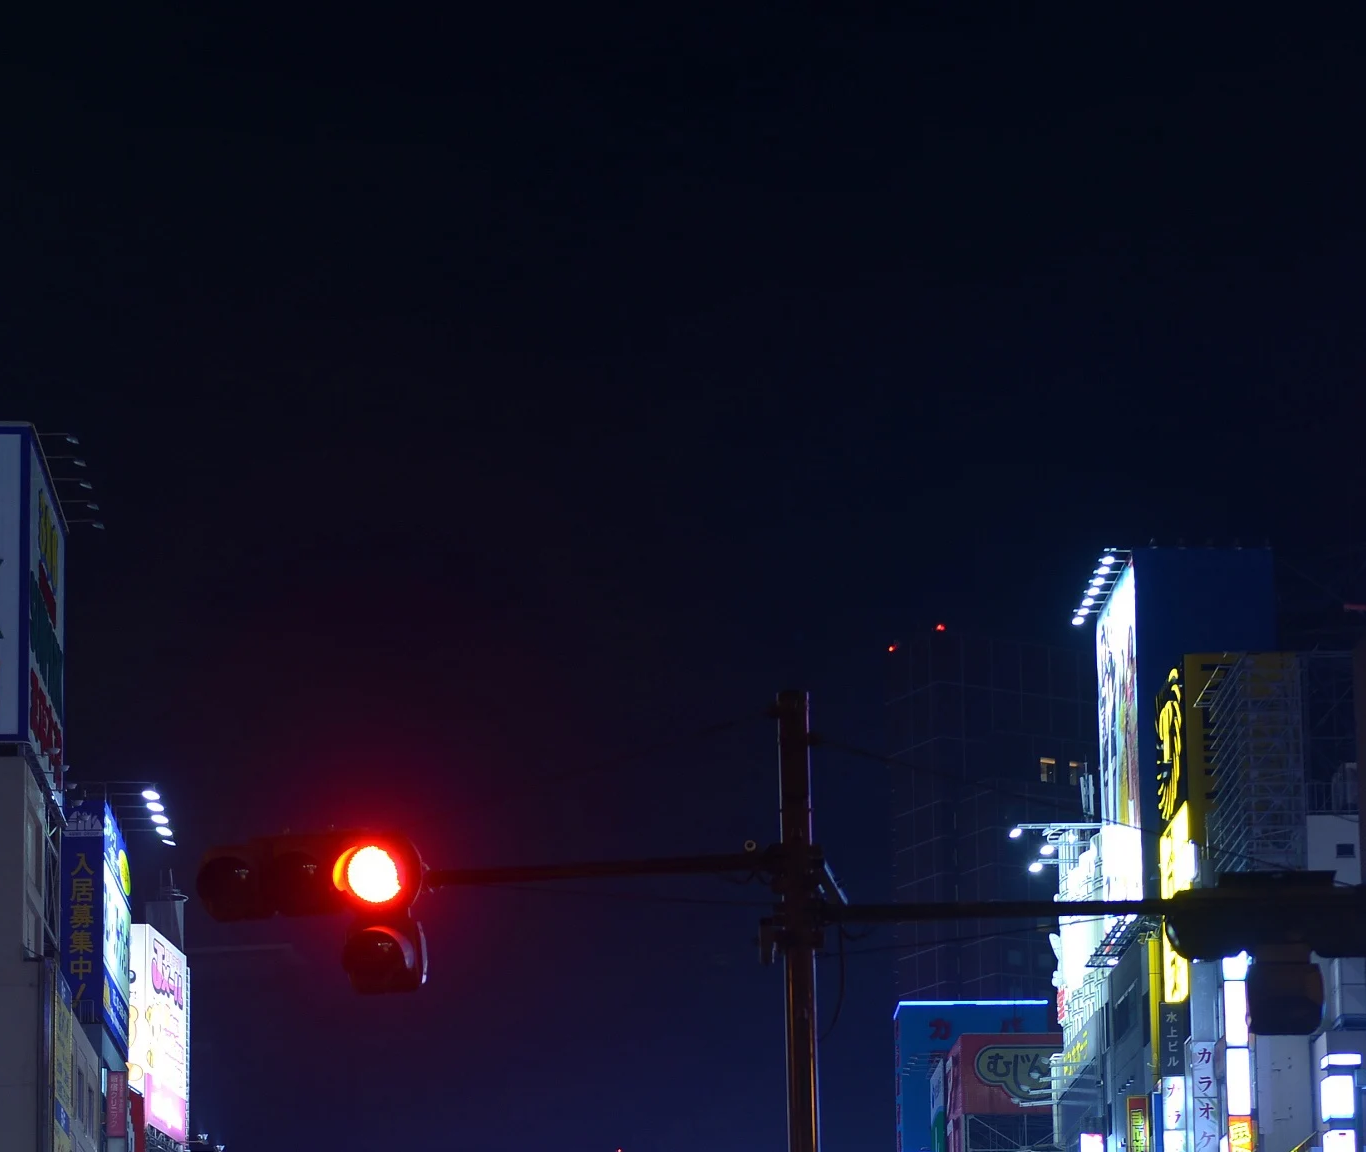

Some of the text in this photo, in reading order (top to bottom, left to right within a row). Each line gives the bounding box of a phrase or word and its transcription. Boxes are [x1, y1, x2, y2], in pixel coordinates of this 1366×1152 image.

[1164, 1010, 1179, 1068] 水上ビル
[1197, 1048, 1216, 1147] カラオケ
